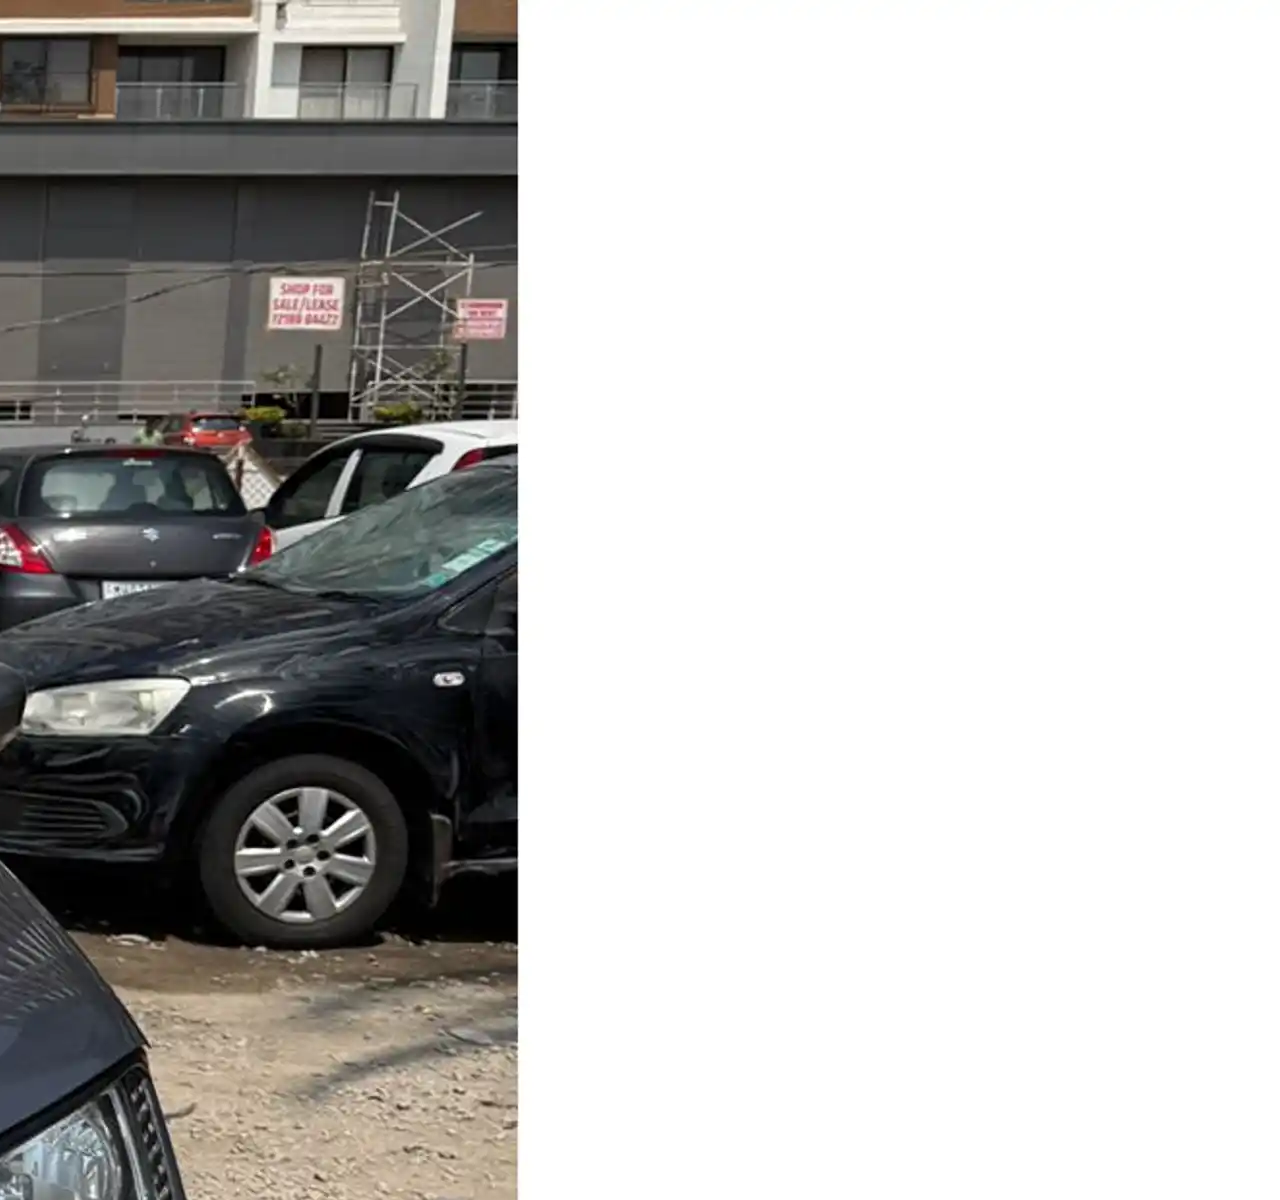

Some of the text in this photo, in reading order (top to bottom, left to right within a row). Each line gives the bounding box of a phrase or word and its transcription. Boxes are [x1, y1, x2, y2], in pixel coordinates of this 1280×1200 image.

[280, 282, 334, 296] SHOP FOR
[273, 298, 339, 312] SALE/LEASE
